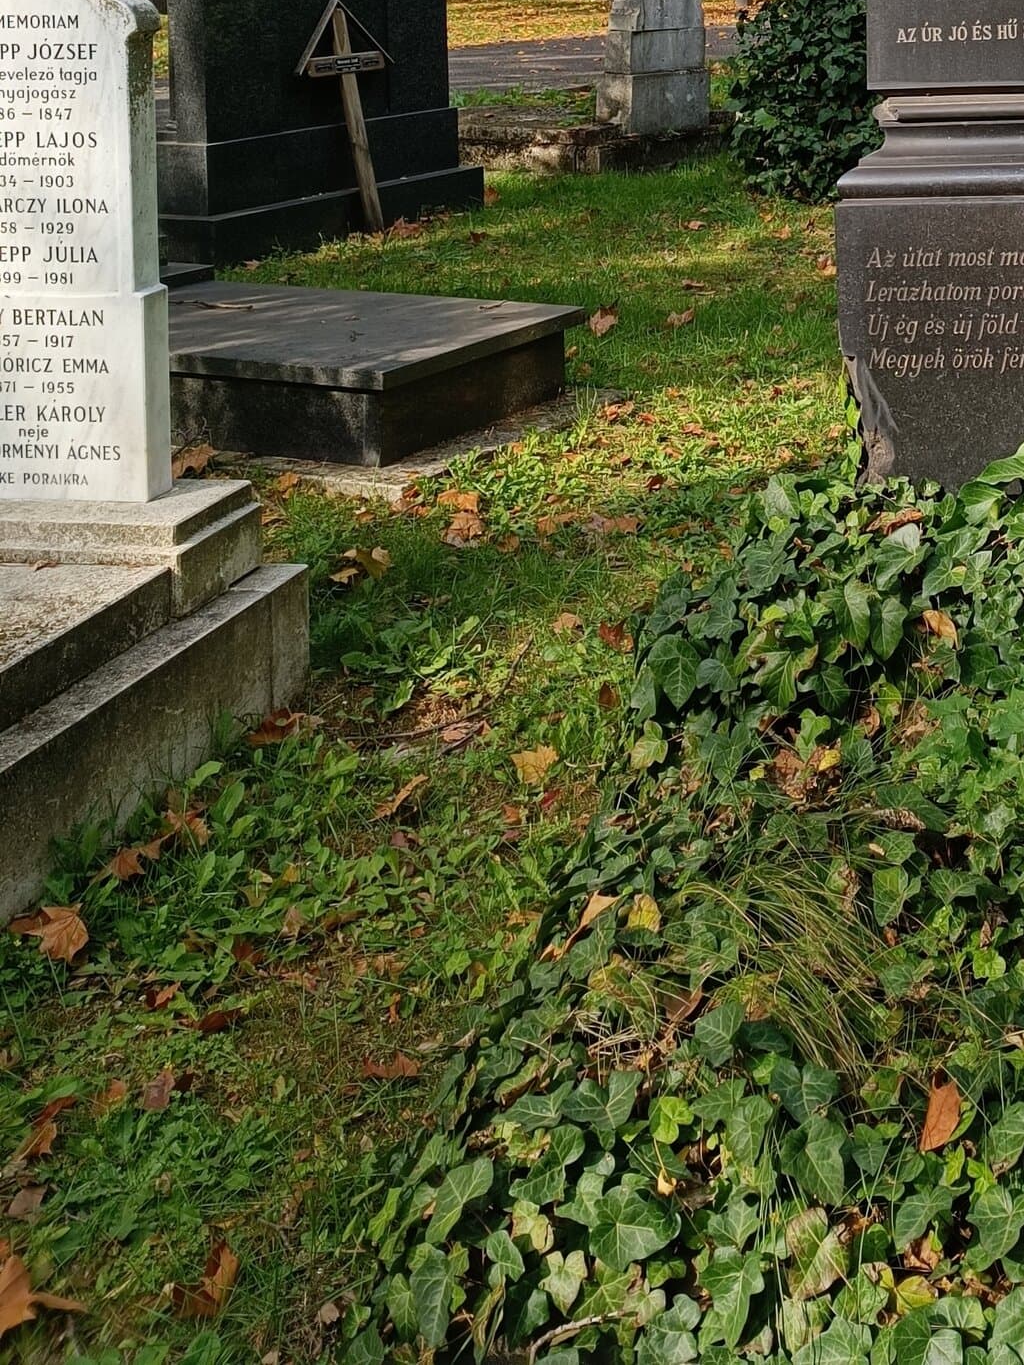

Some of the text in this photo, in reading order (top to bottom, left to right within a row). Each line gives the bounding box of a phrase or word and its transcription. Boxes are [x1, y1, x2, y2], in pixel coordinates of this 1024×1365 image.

[896, 28, 917, 43] AZ
[921, 22, 943, 43] ÚR
[948, 21, 967, 41] JÓ
[972, 19, 992, 41] ÉS
[997, 18, 1018, 40] HŰ
[27, 37, 98, 60] JÓZSEF
[60, 66, 97, 86] tagja
[39, 107, 72, 120] 1847
[36, 131, 97, 148] LAJOS
[40, 175, 74, 188] 1903
[0, 198, 109, 214] RCZY ILONA
[41, 222, 74, 234] 1929
[866, 247, 896, 268] Az
[949, 247, 995, 267] most
[45, 272, 73, 284] 1981
[865, 279, 982, 302] Lerázhatom
[13, 308, 105, 326] BERTALAN
[896, 314, 918, 343] ég
[924, 314, 945, 335] és
[953, 313, 973, 342] új
[978, 313, 1018, 340] föld
[45, 335, 74, 348] 1917
[63, 358, 109, 374] EMMA
[869, 347, 945, 377] Megyek
[952, 347, 994, 369] örök
[41, 381, 75, 394] 1955
[37, 399, 106, 423] KÁROLY
[19, 424, 49, 441] neje
[0, 438, 121, 461] RMÉNYI ÁGNES
[23, 472, 89, 486] PORAIKRA
